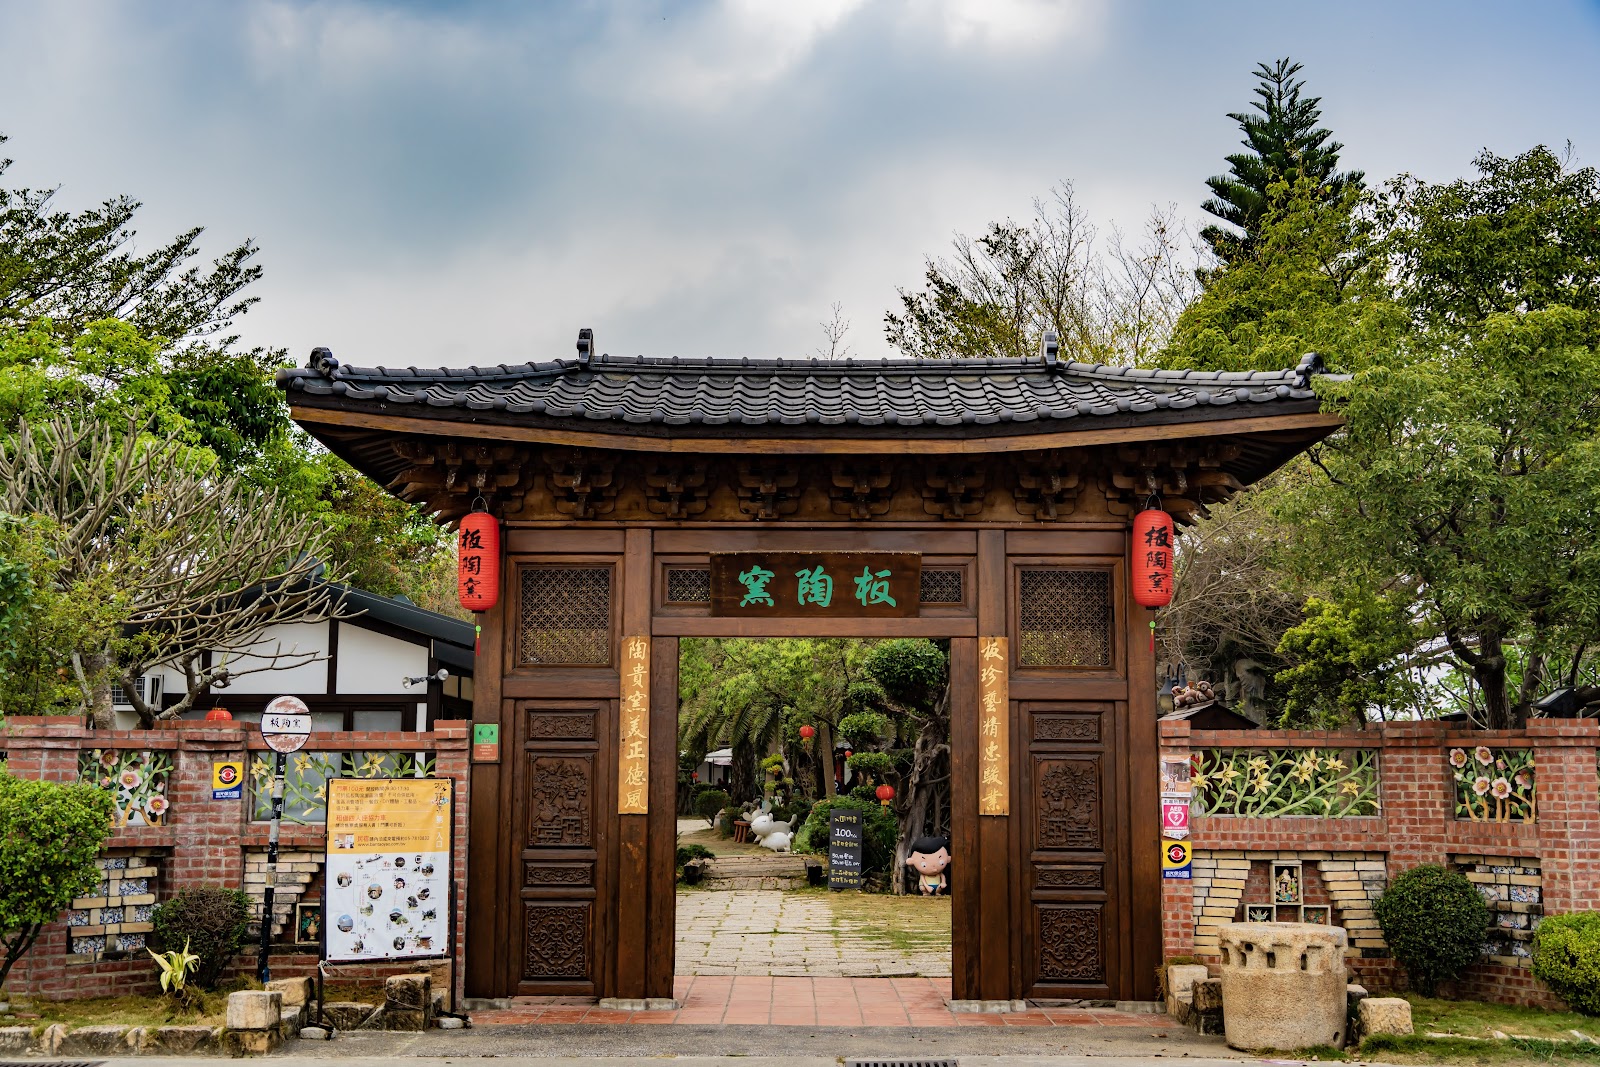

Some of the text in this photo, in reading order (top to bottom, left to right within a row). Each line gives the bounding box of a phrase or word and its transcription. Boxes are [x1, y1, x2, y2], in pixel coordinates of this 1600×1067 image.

[461, 528, 484, 599] 板陶窯
[1144, 526, 1172, 594] 板陶窯
